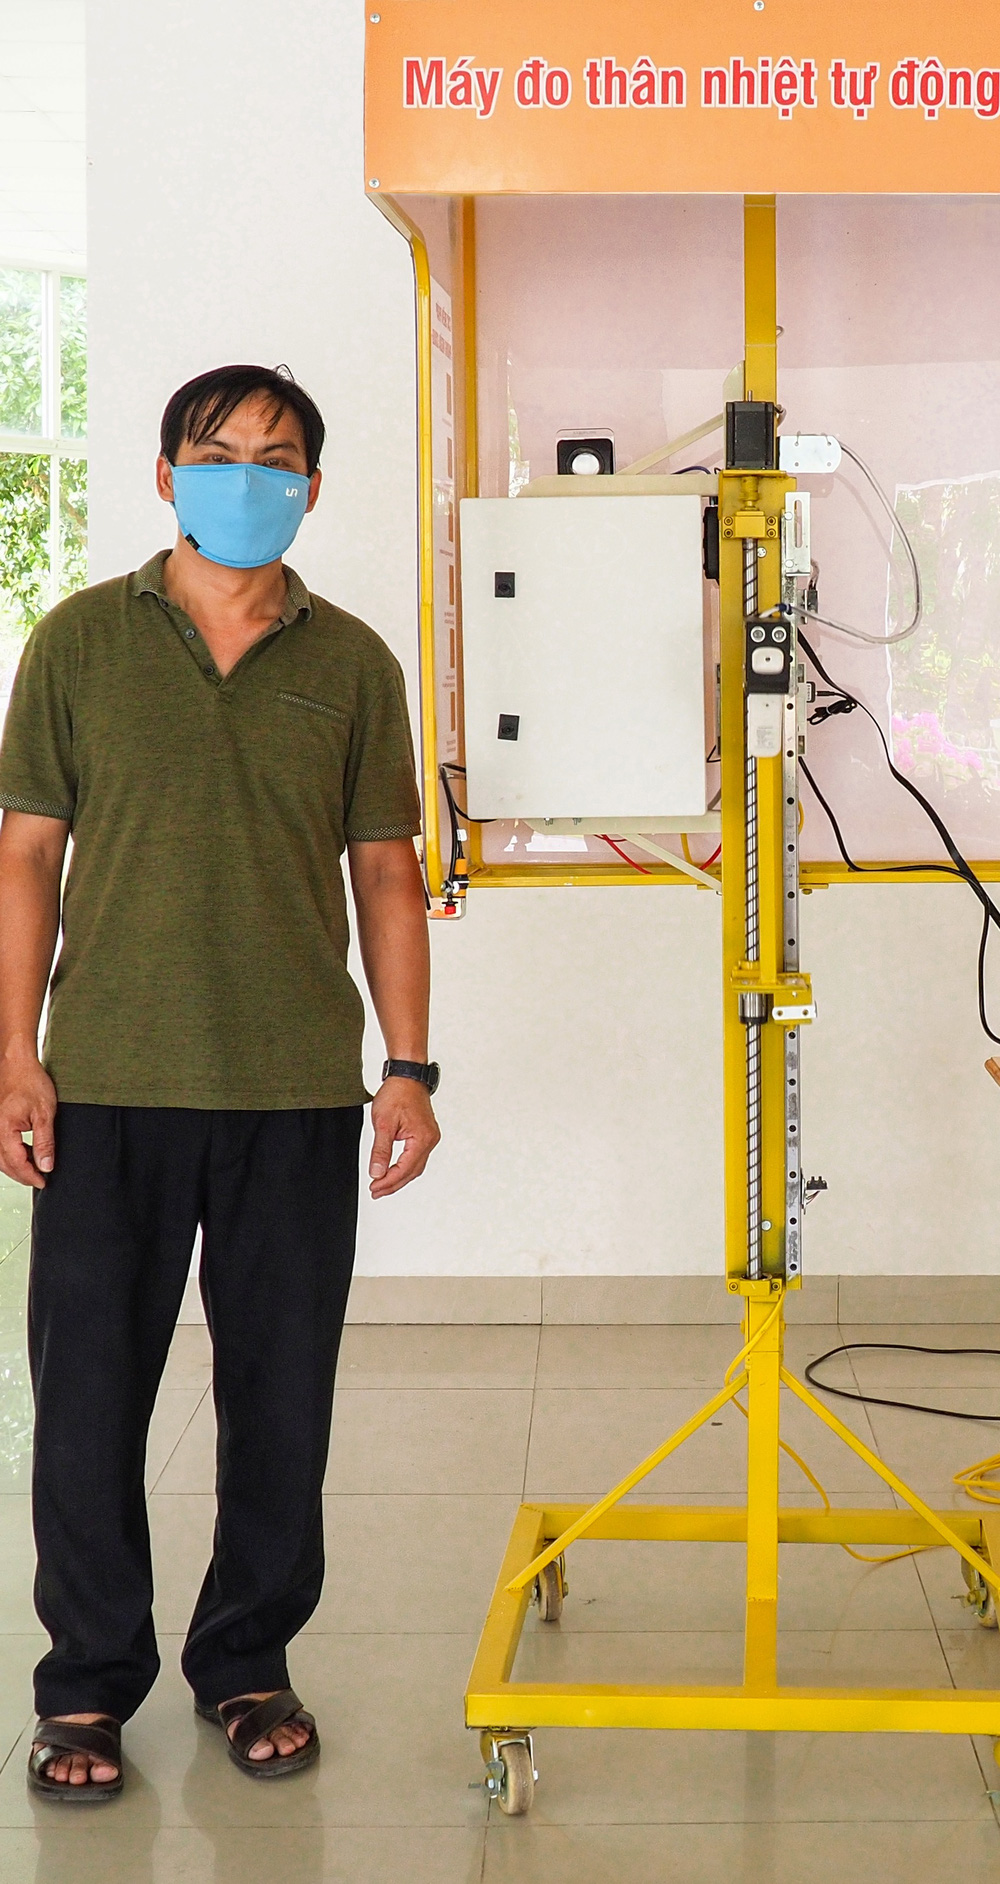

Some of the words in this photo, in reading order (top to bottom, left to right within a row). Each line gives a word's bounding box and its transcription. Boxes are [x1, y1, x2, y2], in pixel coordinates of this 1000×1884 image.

[403, 56, 503, 119] Máy
[514, 57, 572, 109] đo
[583, 55, 687, 109] thân
[701, 55, 818, 120] nhiệt
[829, 58, 880, 120] tự
